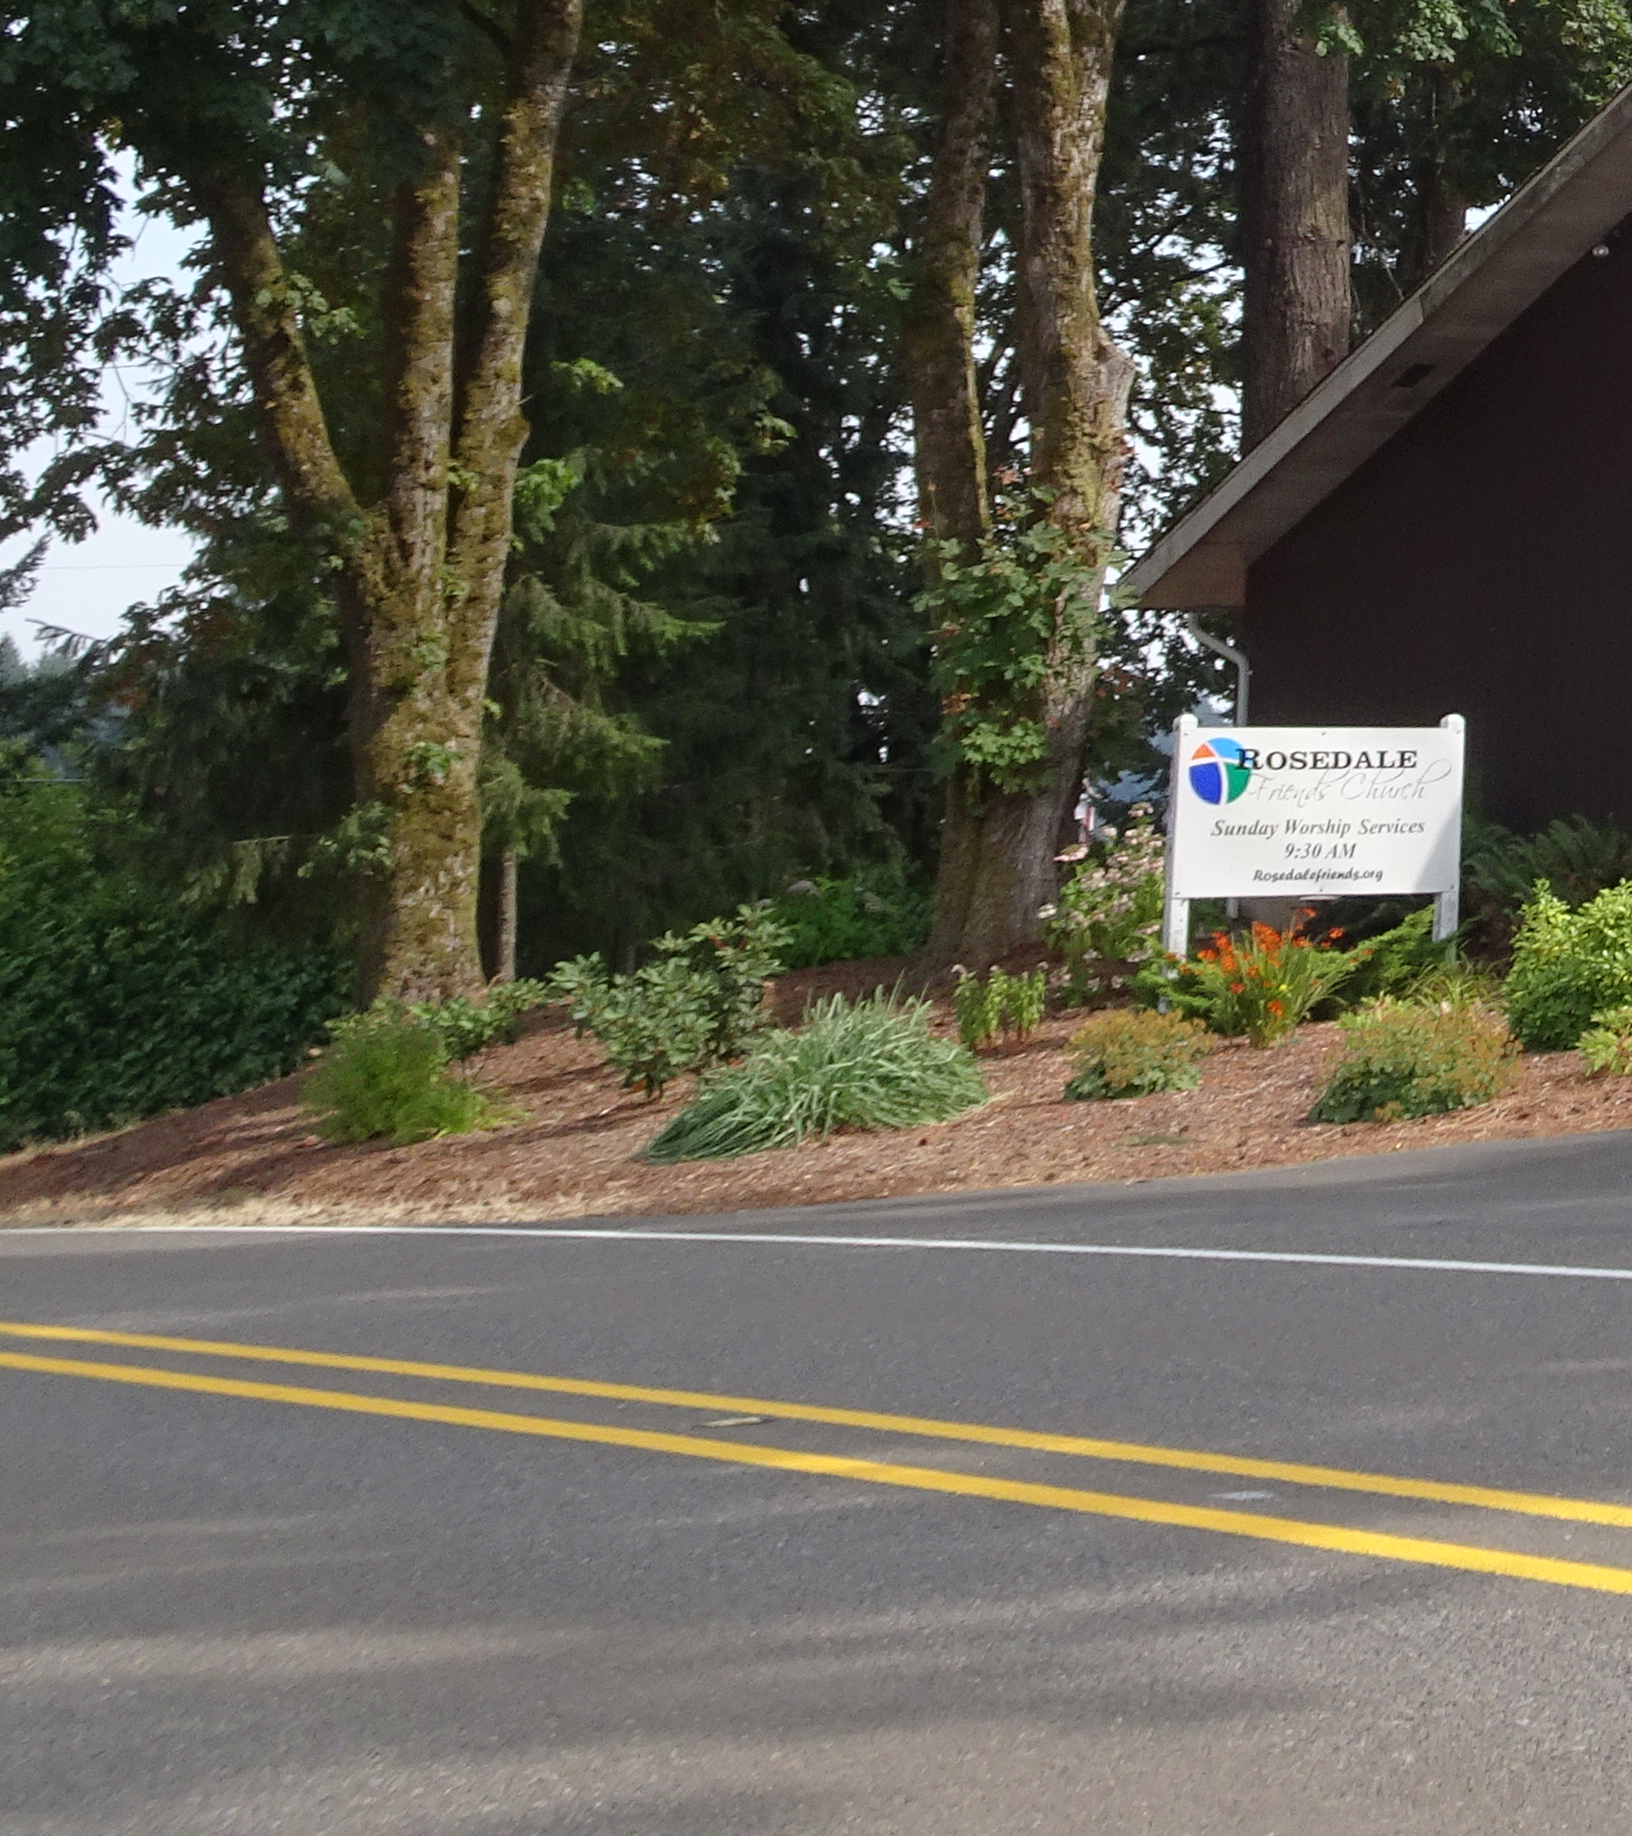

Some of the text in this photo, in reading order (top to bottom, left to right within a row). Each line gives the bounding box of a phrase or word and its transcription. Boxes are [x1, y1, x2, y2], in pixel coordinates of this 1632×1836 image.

[1235, 748, 1418, 771] ROSEDALE
[1247, 759, 1452, 808] Friends Church
[1210, 817, 1425, 839] Sunday Worship Services
[1284, 842, 1357, 859] 9:30 AM
[1252, 867, 1384, 882] Rosedalefriends.org
